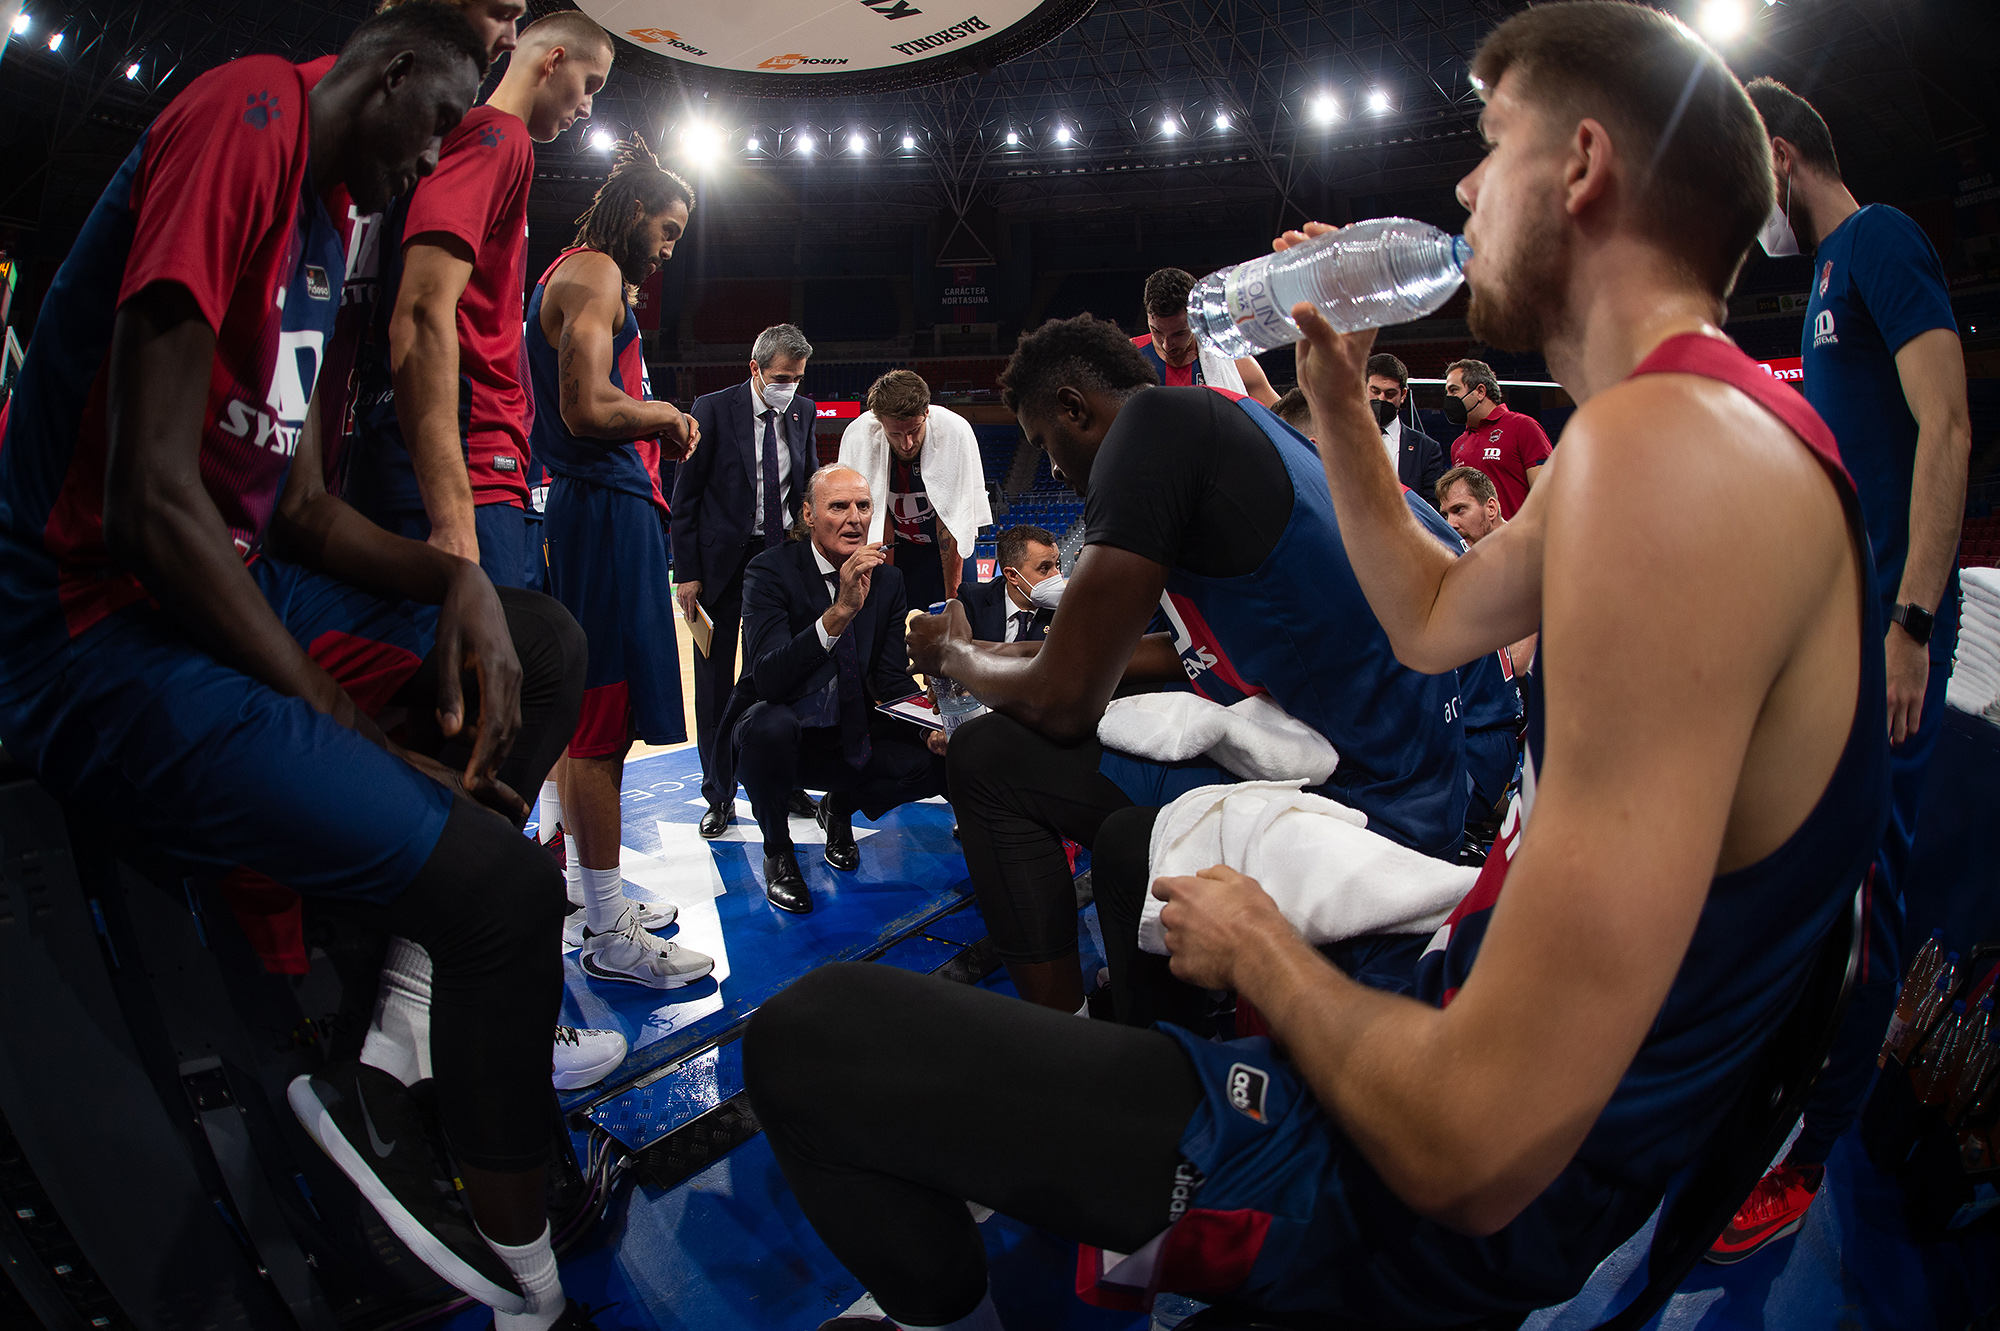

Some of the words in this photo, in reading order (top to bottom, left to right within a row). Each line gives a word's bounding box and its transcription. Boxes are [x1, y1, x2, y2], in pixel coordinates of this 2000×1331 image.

[890, 15, 991, 57] BASKONIA
[639, 29, 708, 57] KIROLBET
[767, 56, 849, 67] KIROLBET
[944, 286, 986, 296] CARÁCTER
[941, 296, 989, 305] NORTASUNA
